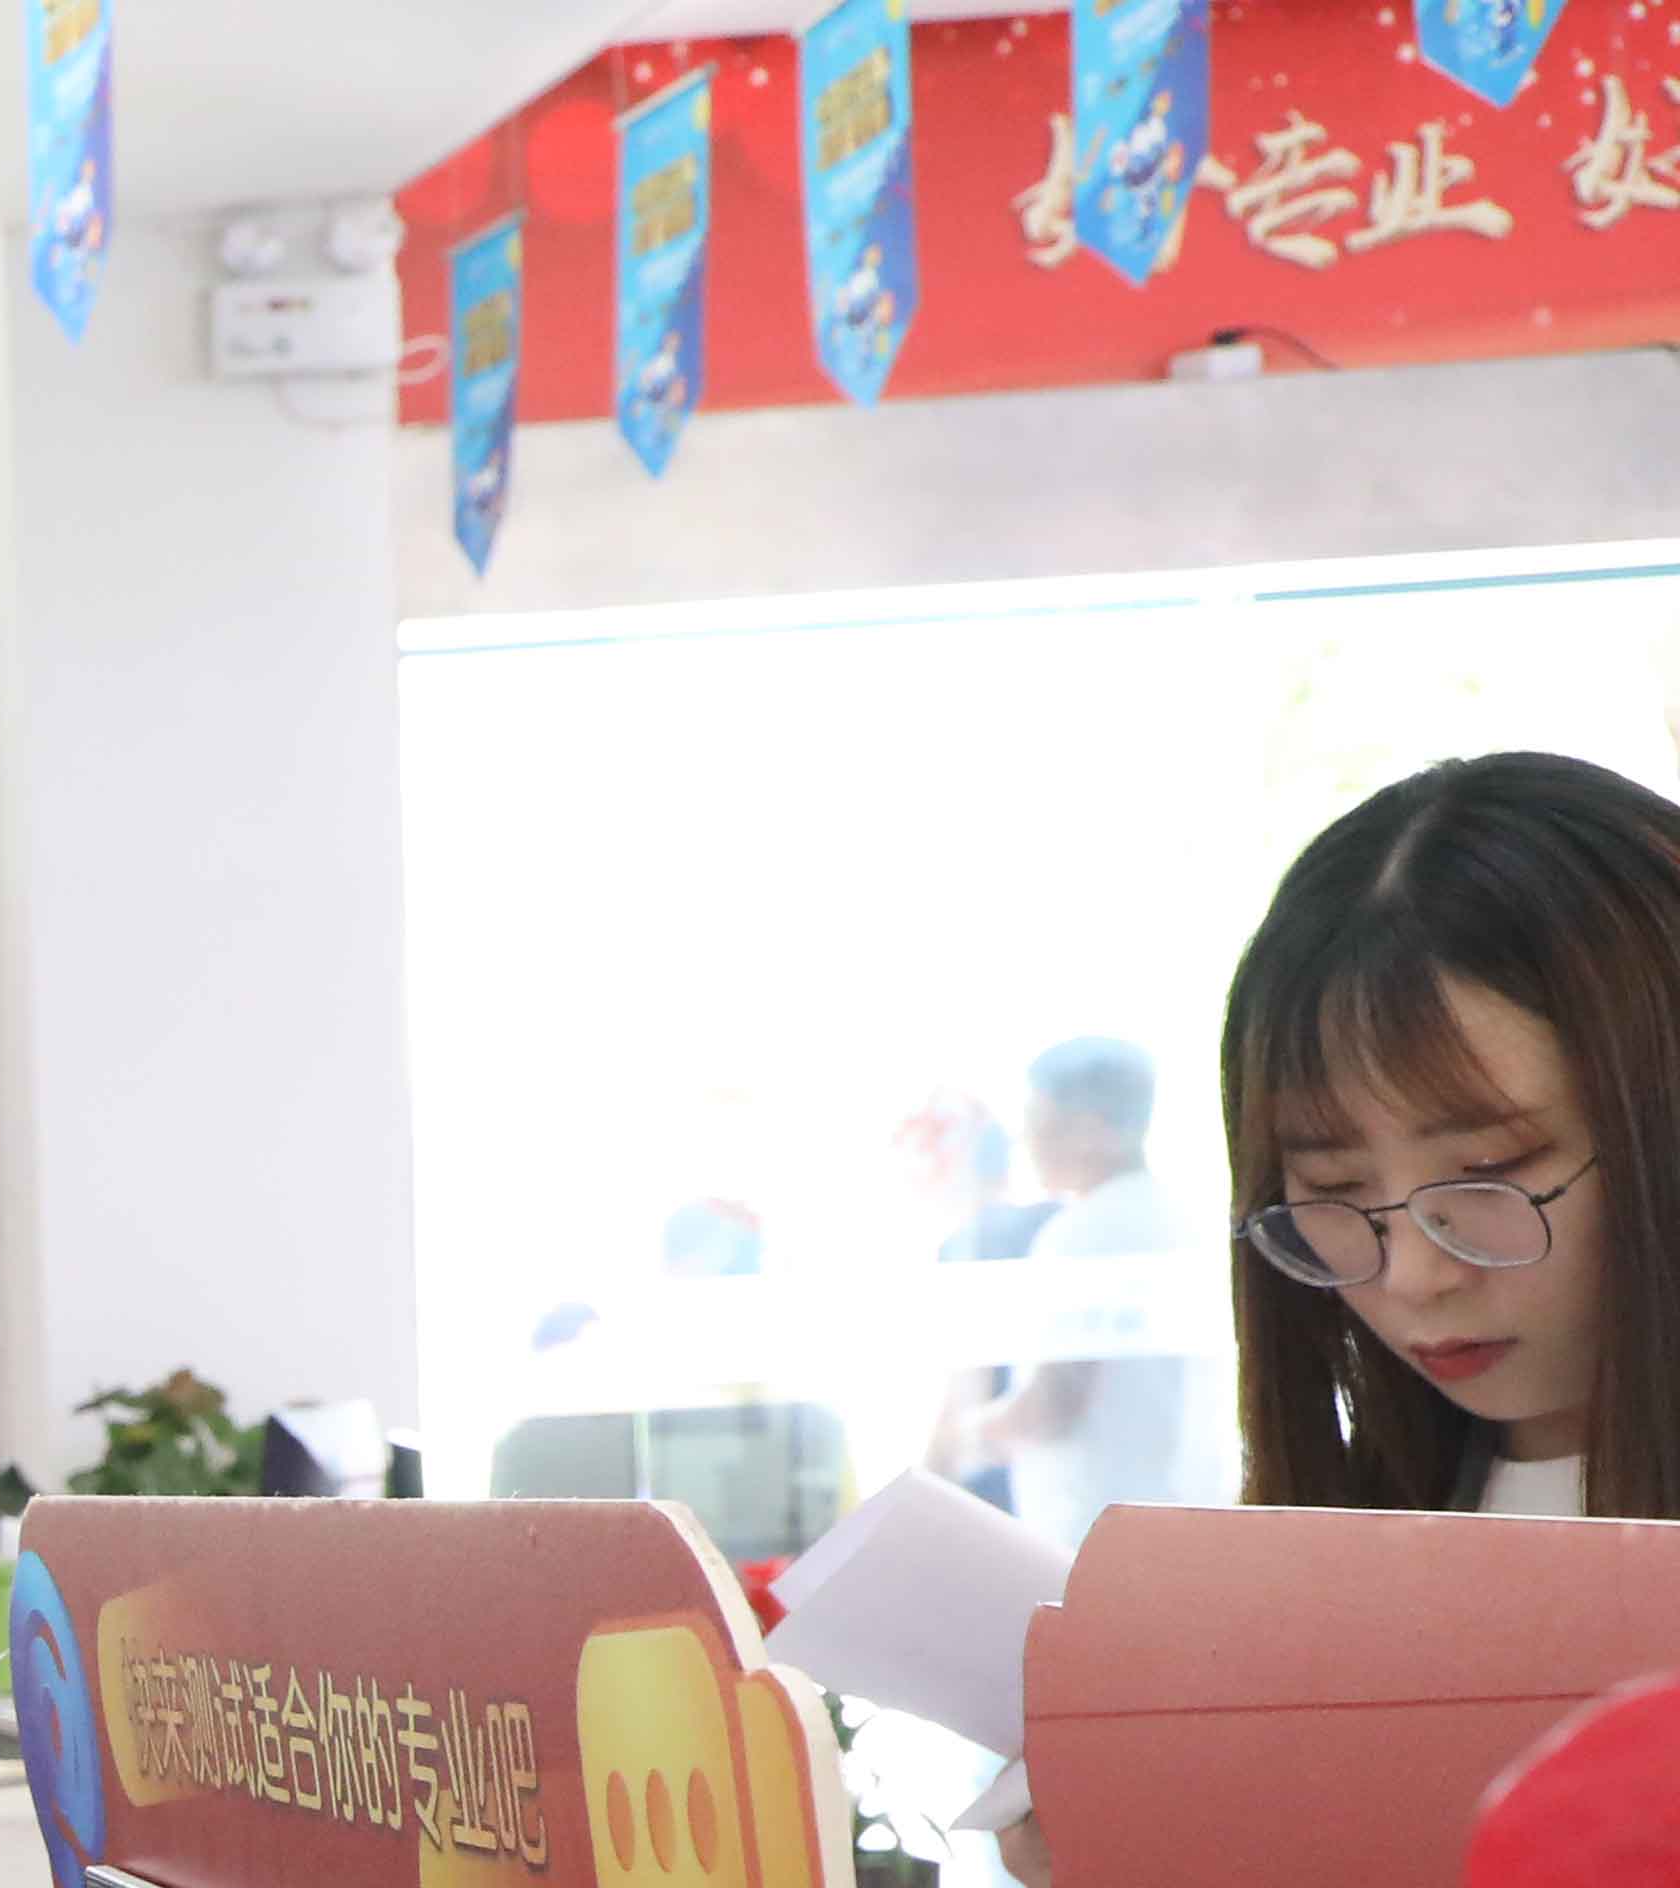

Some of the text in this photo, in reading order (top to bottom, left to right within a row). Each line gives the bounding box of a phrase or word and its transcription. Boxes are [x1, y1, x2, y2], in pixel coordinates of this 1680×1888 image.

[120, 1635, 548, 1867] 快来测试适合你的专业吧
